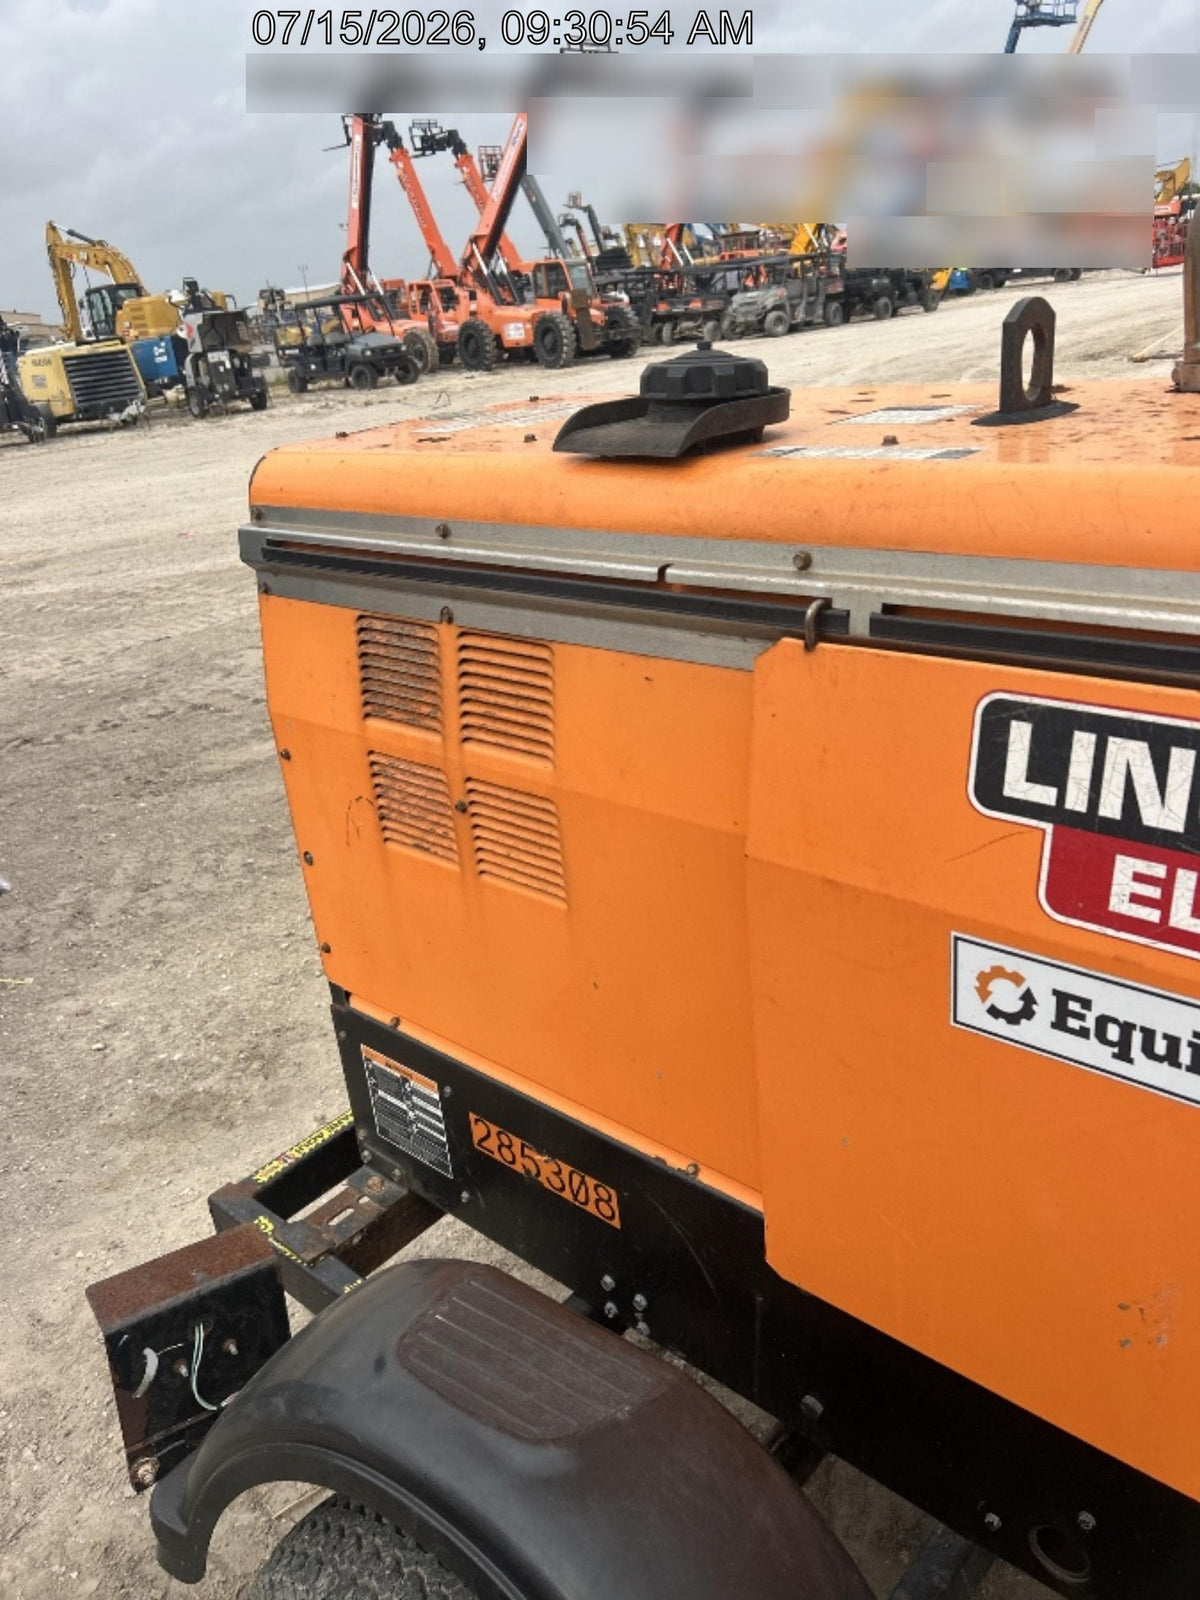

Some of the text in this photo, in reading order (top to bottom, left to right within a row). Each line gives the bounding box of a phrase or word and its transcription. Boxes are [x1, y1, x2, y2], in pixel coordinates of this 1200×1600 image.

[1003, 720, 1200, 834] LIN
[1108, 854, 1200, 935] EL
[1051, 988, 1200, 1076] Equi
[474, 1118, 616, 1221] 285308
